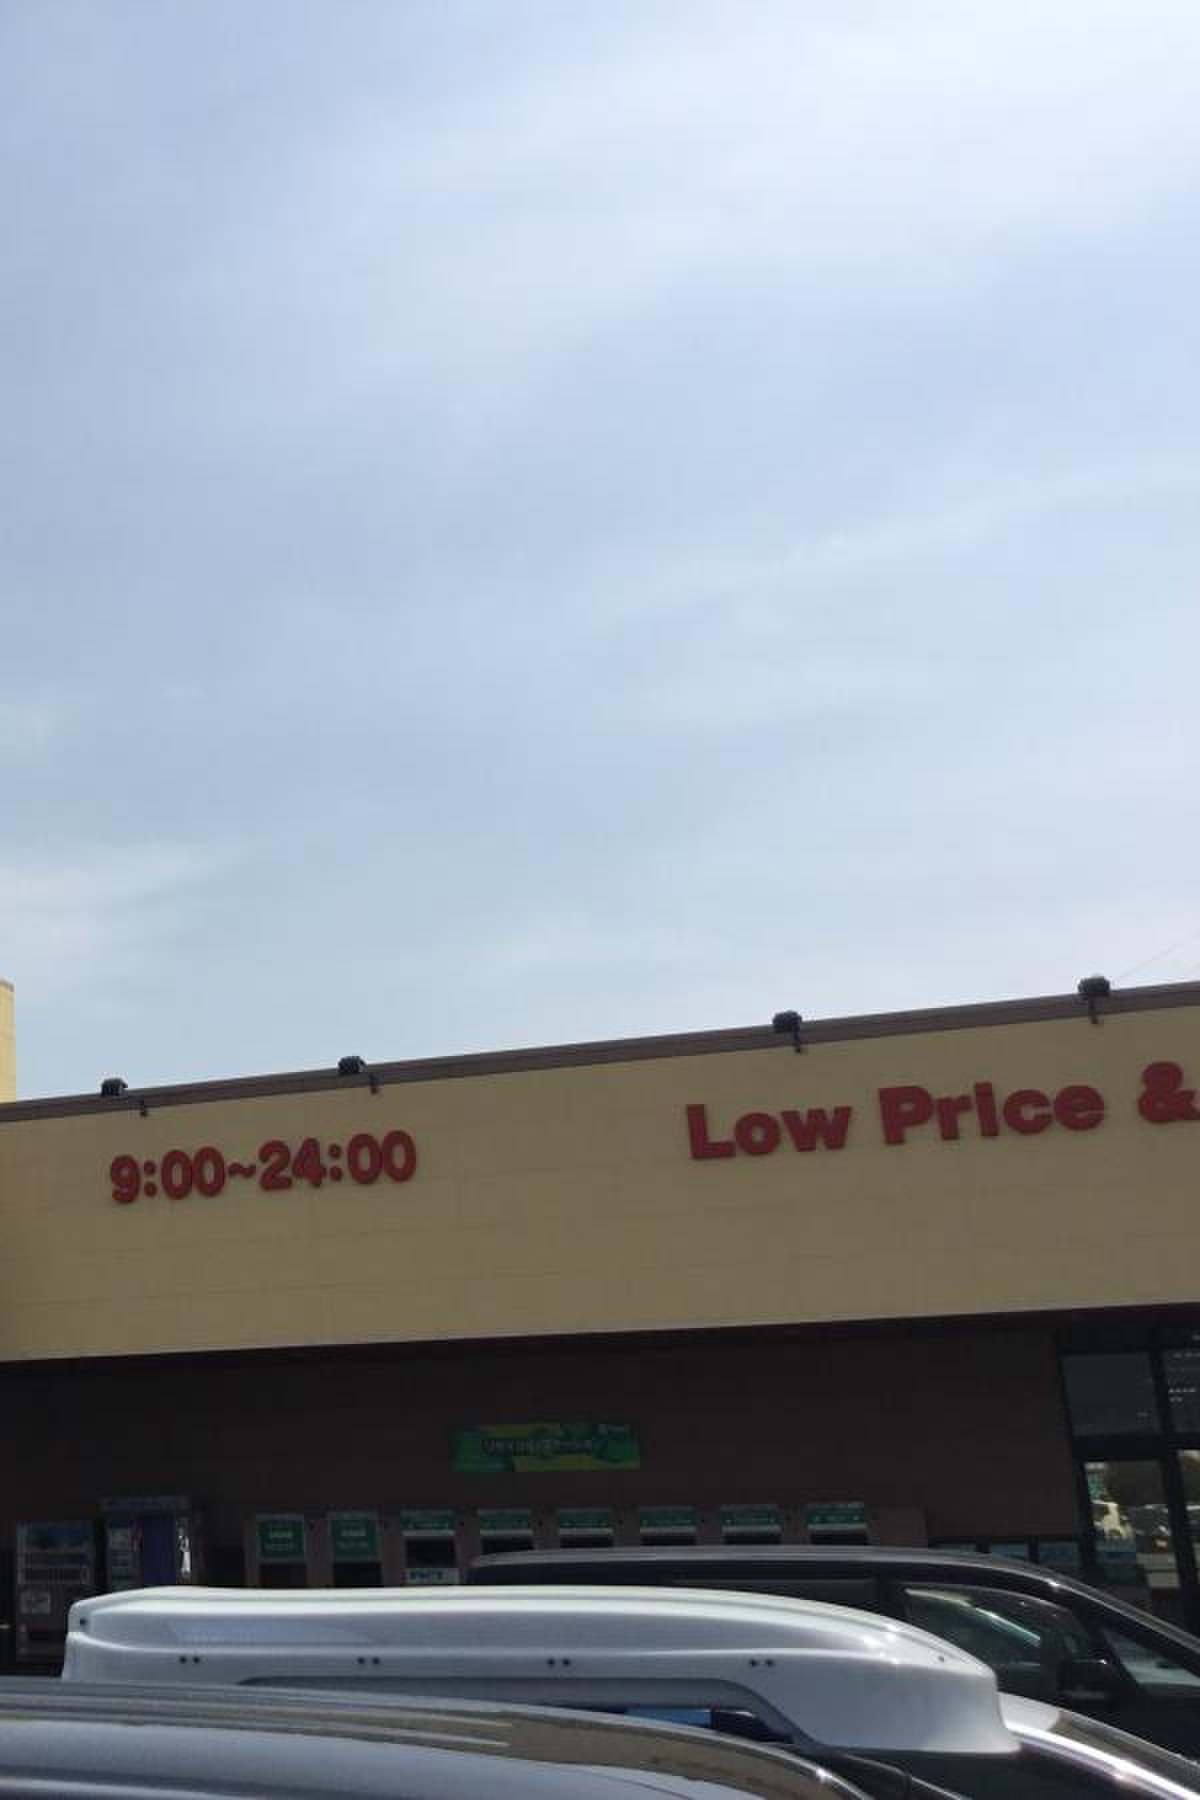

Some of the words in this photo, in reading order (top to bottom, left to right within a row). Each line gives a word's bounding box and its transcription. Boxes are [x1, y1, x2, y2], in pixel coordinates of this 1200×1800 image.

[686, 1103, 852, 1160] Low
[878, 1081, 1105, 1145] Price
[1138, 1061, 1200, 1123] &
[110, 1130, 417, 1203] 9:00~24:00
